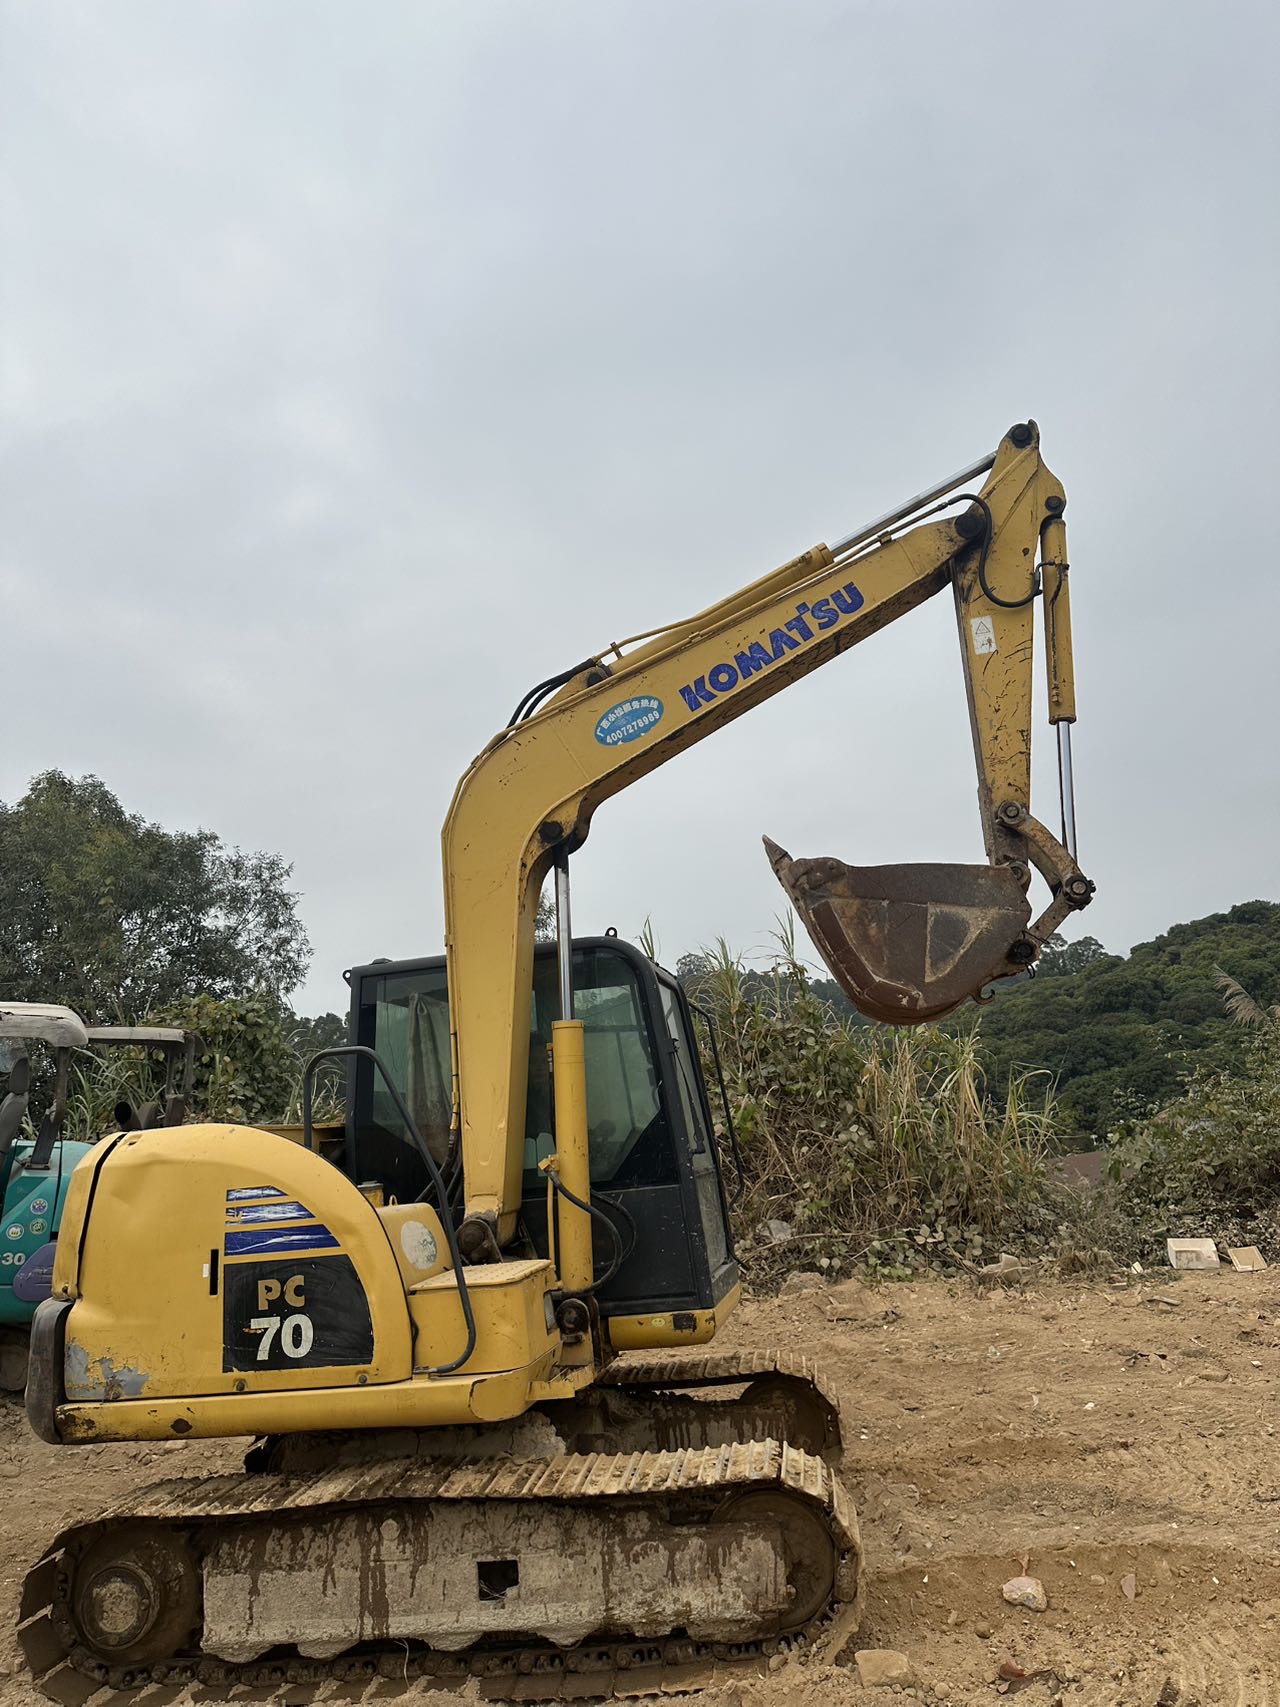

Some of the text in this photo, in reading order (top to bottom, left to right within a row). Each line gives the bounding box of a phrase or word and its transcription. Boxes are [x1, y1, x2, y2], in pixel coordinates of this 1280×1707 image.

[679, 582, 865, 712] KOMATSU
[606, 710, 660, 744] 4007278989
[0, 1252, 26, 1266] 30
[258, 1275, 305, 1311] PC
[250, 1313, 314, 1361] 70
